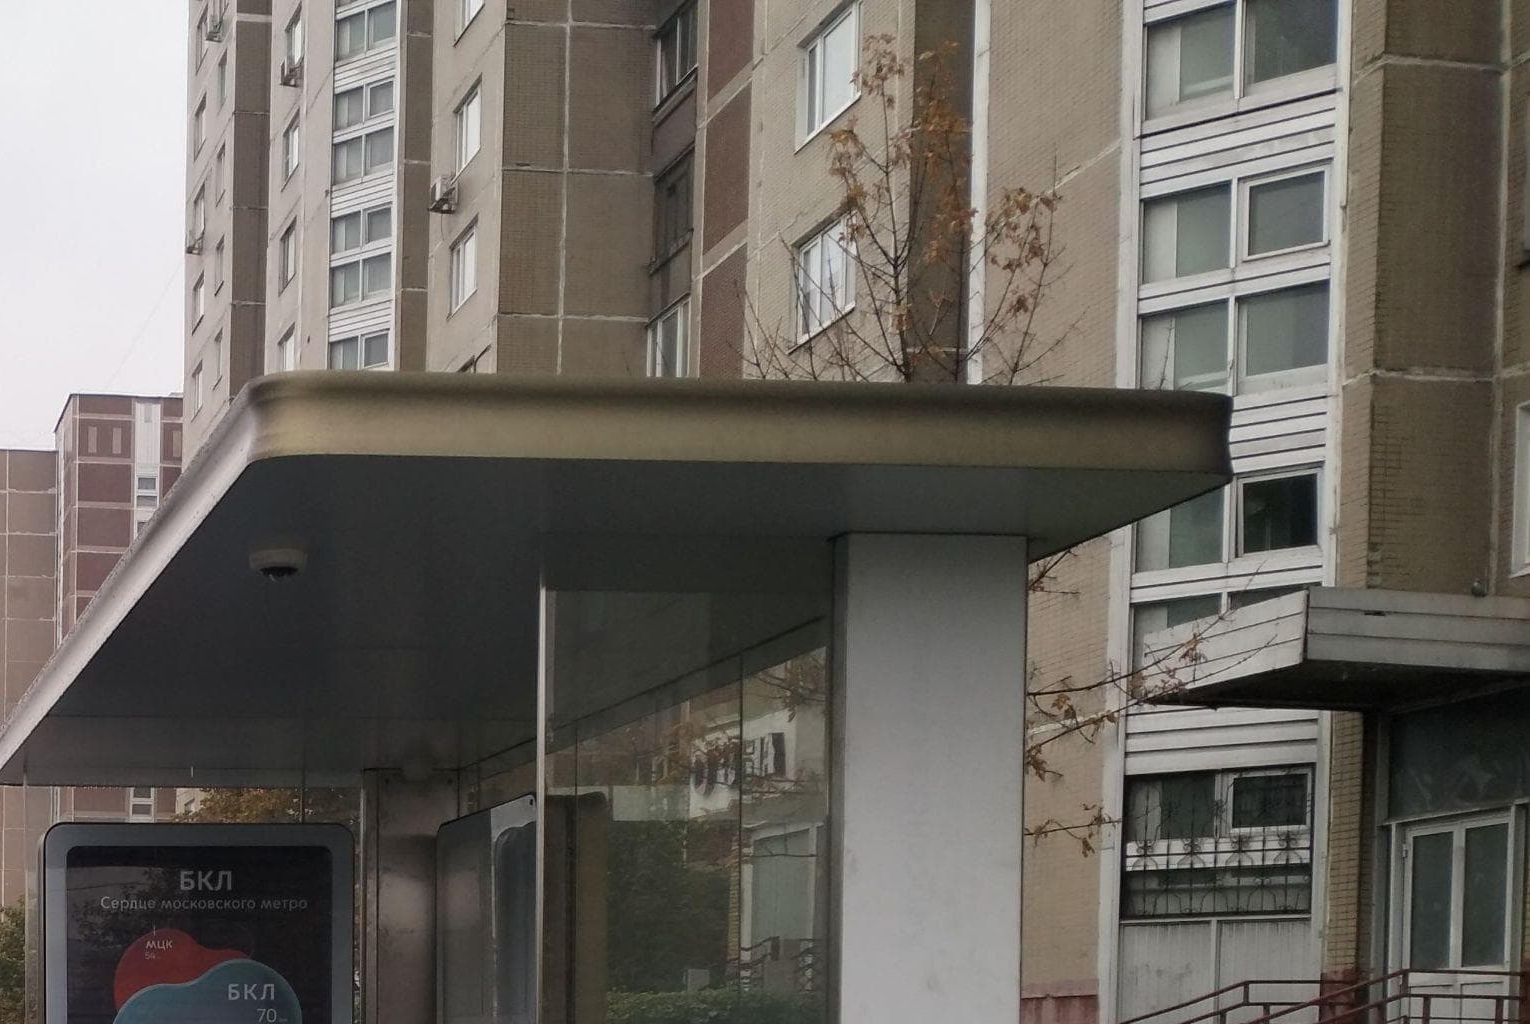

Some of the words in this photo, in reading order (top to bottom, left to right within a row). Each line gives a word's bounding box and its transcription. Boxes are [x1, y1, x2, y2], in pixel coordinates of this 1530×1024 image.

[180, 870, 233, 891] БКЛ
[100, 896, 156, 911] Сердце
[160, 899, 256, 910] московского
[260, 899, 308, 911] метро
[145, 940, 173, 950] МЦК
[227, 983, 275, 1001] БКЛ
[256, 1008, 277, 1023] 70
